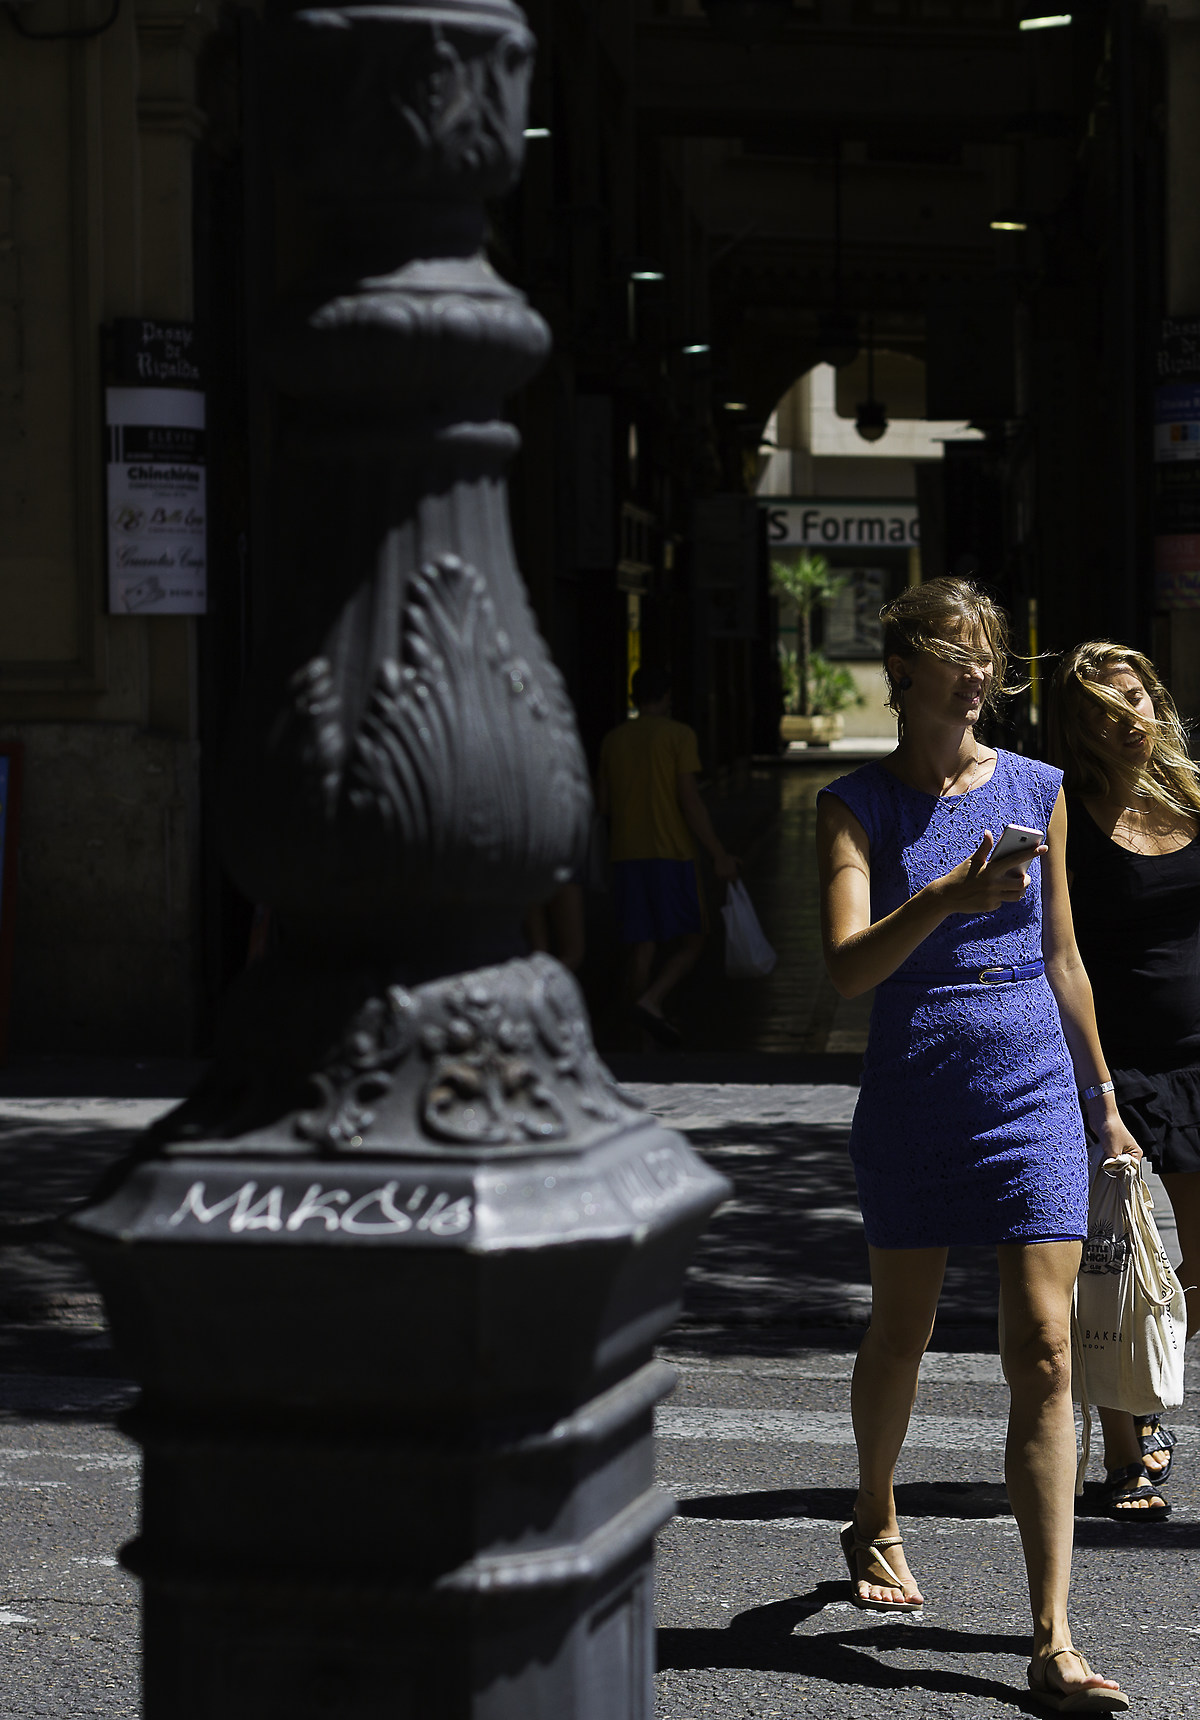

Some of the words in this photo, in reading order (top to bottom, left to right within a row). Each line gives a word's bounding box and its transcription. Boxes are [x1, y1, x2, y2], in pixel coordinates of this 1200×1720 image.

[1087, 1245, 1109, 1253] STYLE
[1085, 1254, 1108, 1262] HIGH
[1085, 1330, 1122, 1342] BAKER
